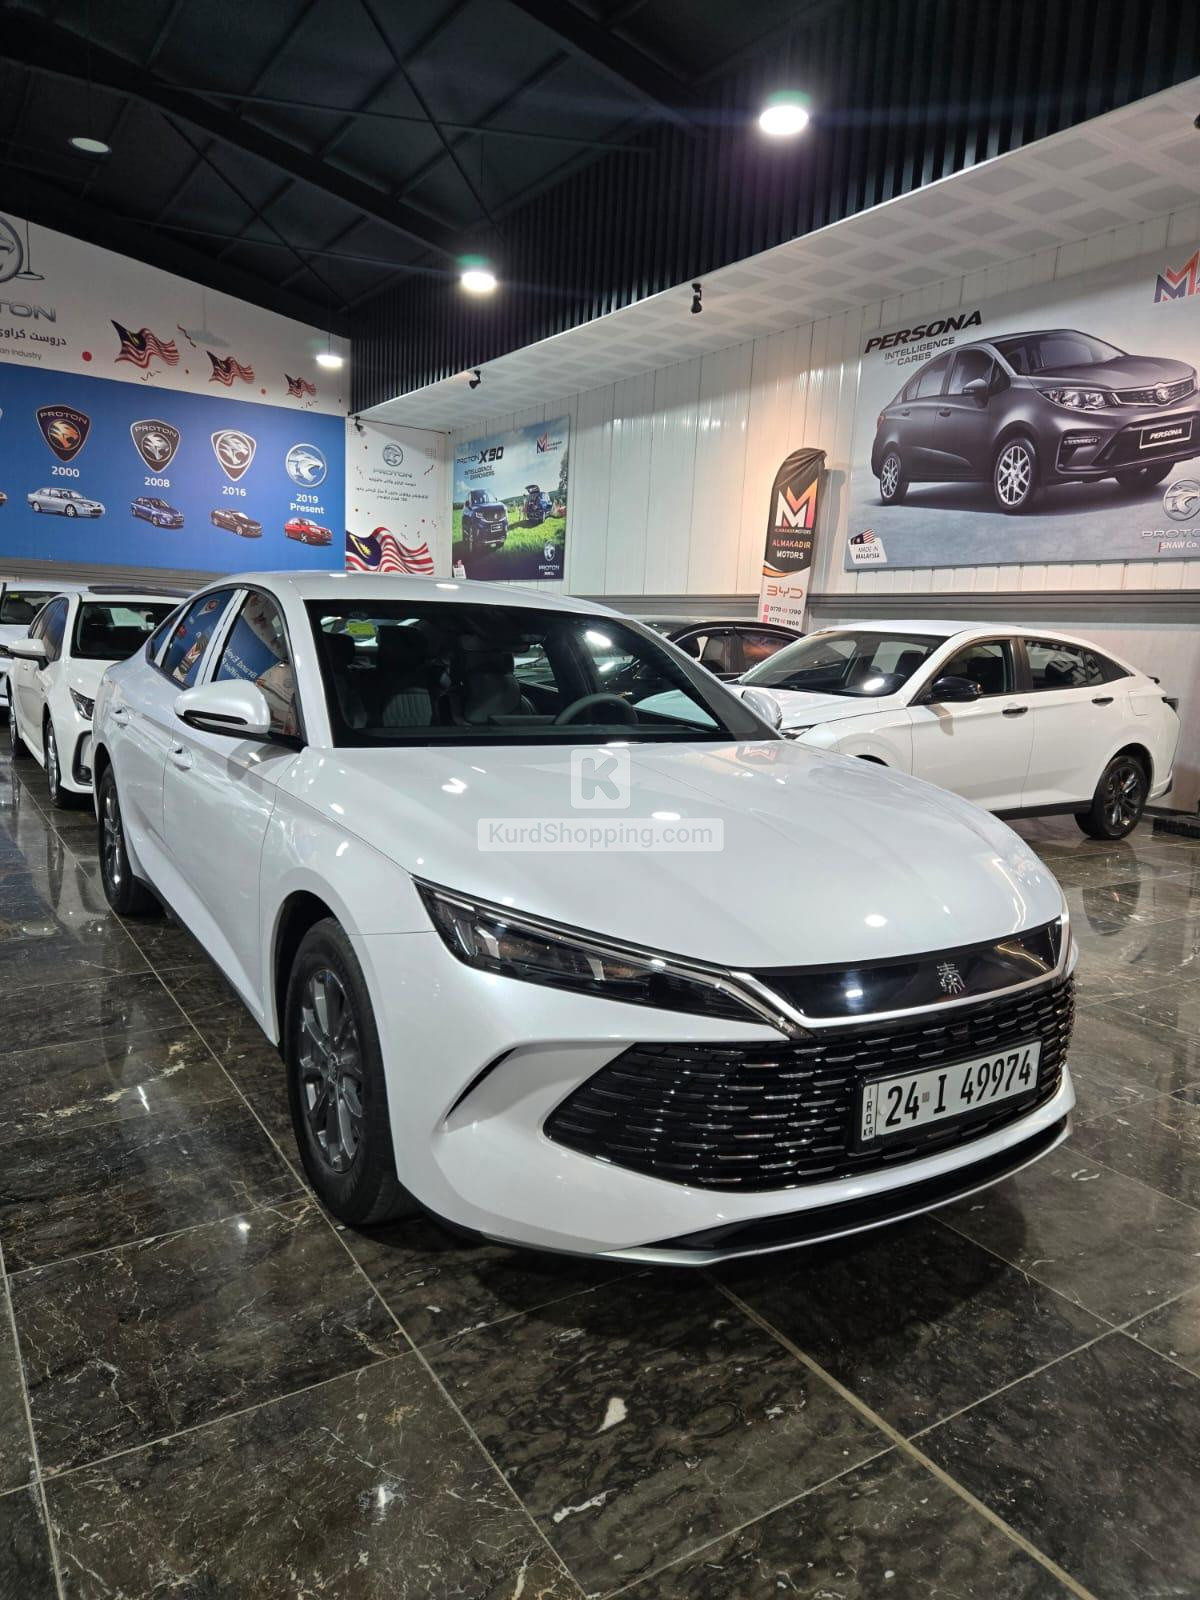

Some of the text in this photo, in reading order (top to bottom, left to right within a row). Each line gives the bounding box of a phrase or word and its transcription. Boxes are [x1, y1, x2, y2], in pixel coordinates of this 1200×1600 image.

[865, 310, 982, 354] PERSONA
[884, 336, 955, 361] INTELLIGENCE
[897, 351, 932, 366] CARES
[40, 411, 87, 425] PROTON
[135, 425, 177, 438] PROTON
[479, 446, 504, 464] X90
[51, 466, 80, 478] 2000
[144, 476, 170, 488] 2008
[222, 486, 247, 497] 2016
[296, 493, 319, 504] 2019
[290, 502, 325, 514] Present
[772, 539, 812, 550] ALMAKADIR
[776, 550, 804, 559] MOTORS
[766, 584, 803, 599] BYD
[885, 1050, 1032, 1127] 24 I 49974
